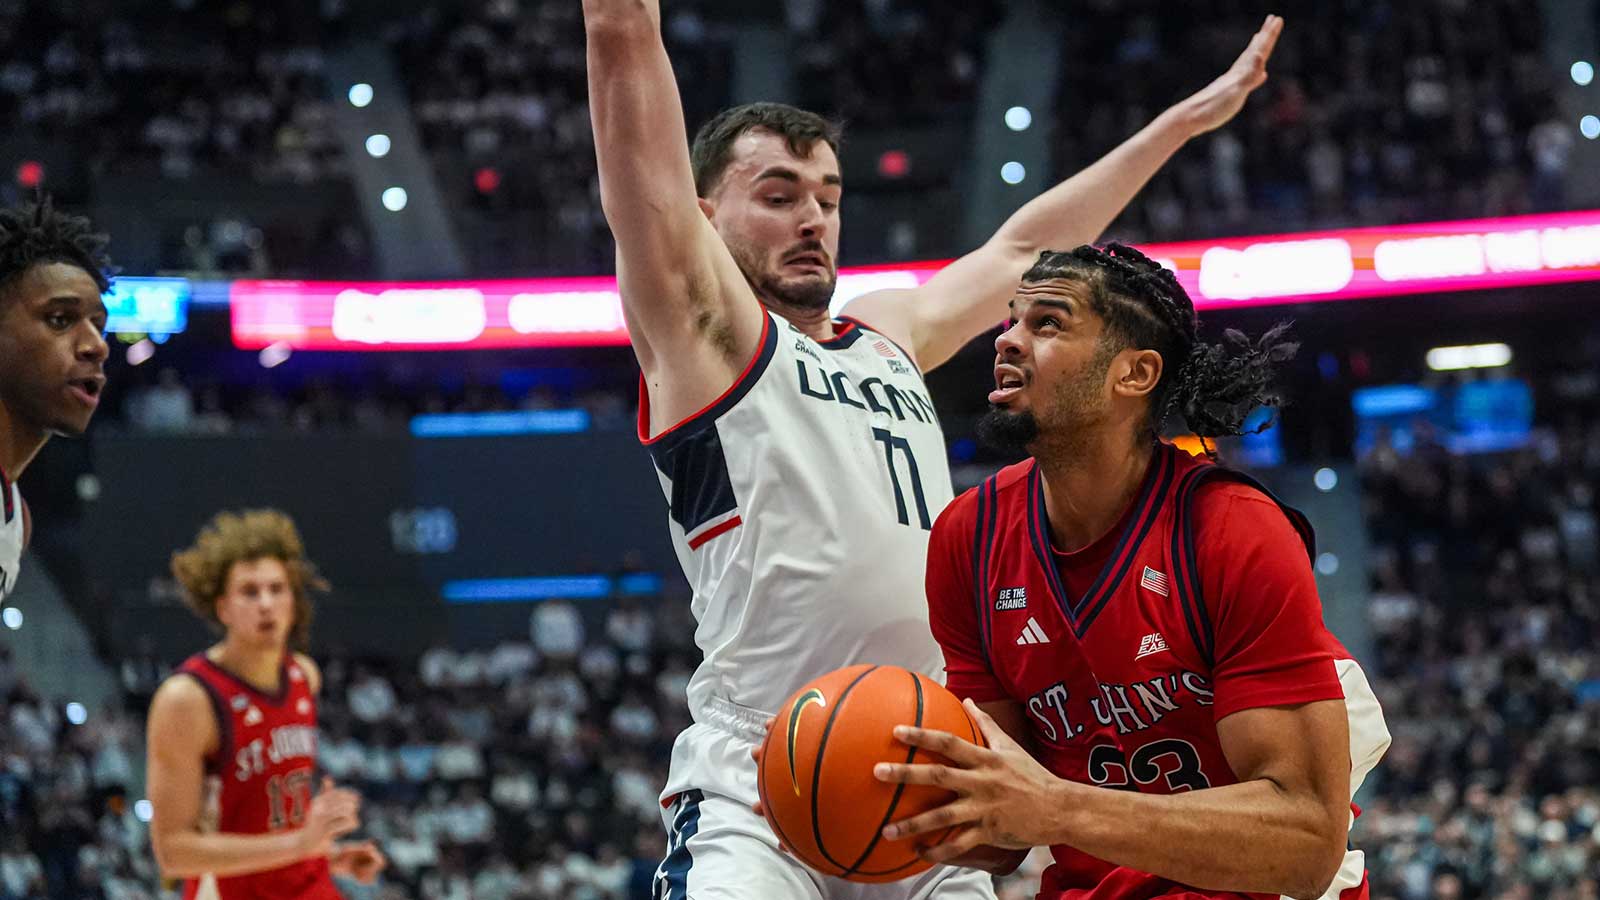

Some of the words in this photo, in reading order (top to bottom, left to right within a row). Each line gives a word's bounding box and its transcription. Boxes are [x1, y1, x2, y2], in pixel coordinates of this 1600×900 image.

[872, 427, 932, 531] 11
[999, 589, 1012, 600] BE
[1012, 587, 1026, 599] THE
[995, 597, 1027, 611] CHANGE
[1140, 632, 1164, 646] BIG
[1136, 640, 1169, 655] EAS
[1028, 683, 1083, 742] ST.
[1091, 671, 1214, 734] JHN'S
